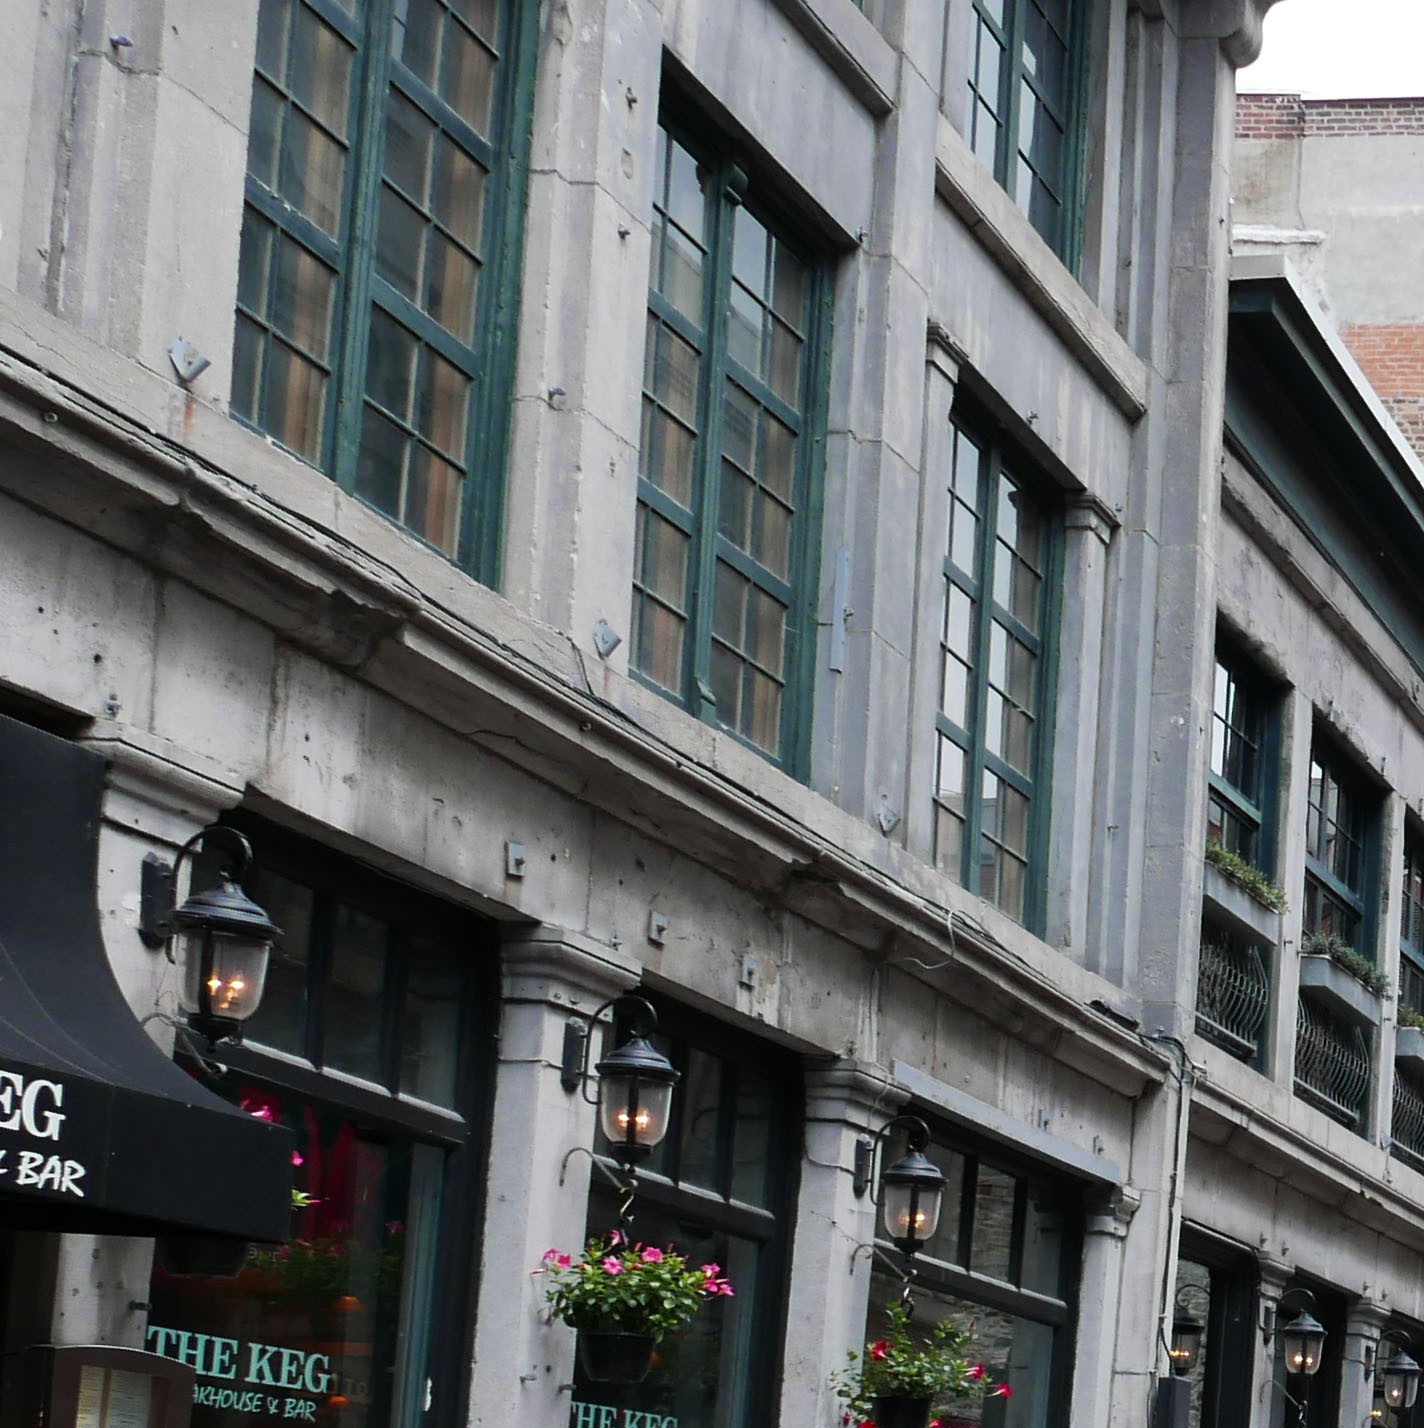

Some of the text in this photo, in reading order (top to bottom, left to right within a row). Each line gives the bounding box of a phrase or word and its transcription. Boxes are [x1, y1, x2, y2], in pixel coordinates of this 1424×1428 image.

[0, 1070, 67, 1141] EG
[16, 1150, 87, 1198] BAR
[147, 1325, 239, 1380] THE
[244, 1342, 334, 1394] KEG
[193, 1384, 264, 1413] KHOUSE
[283, 1398, 317, 1422] BAR
